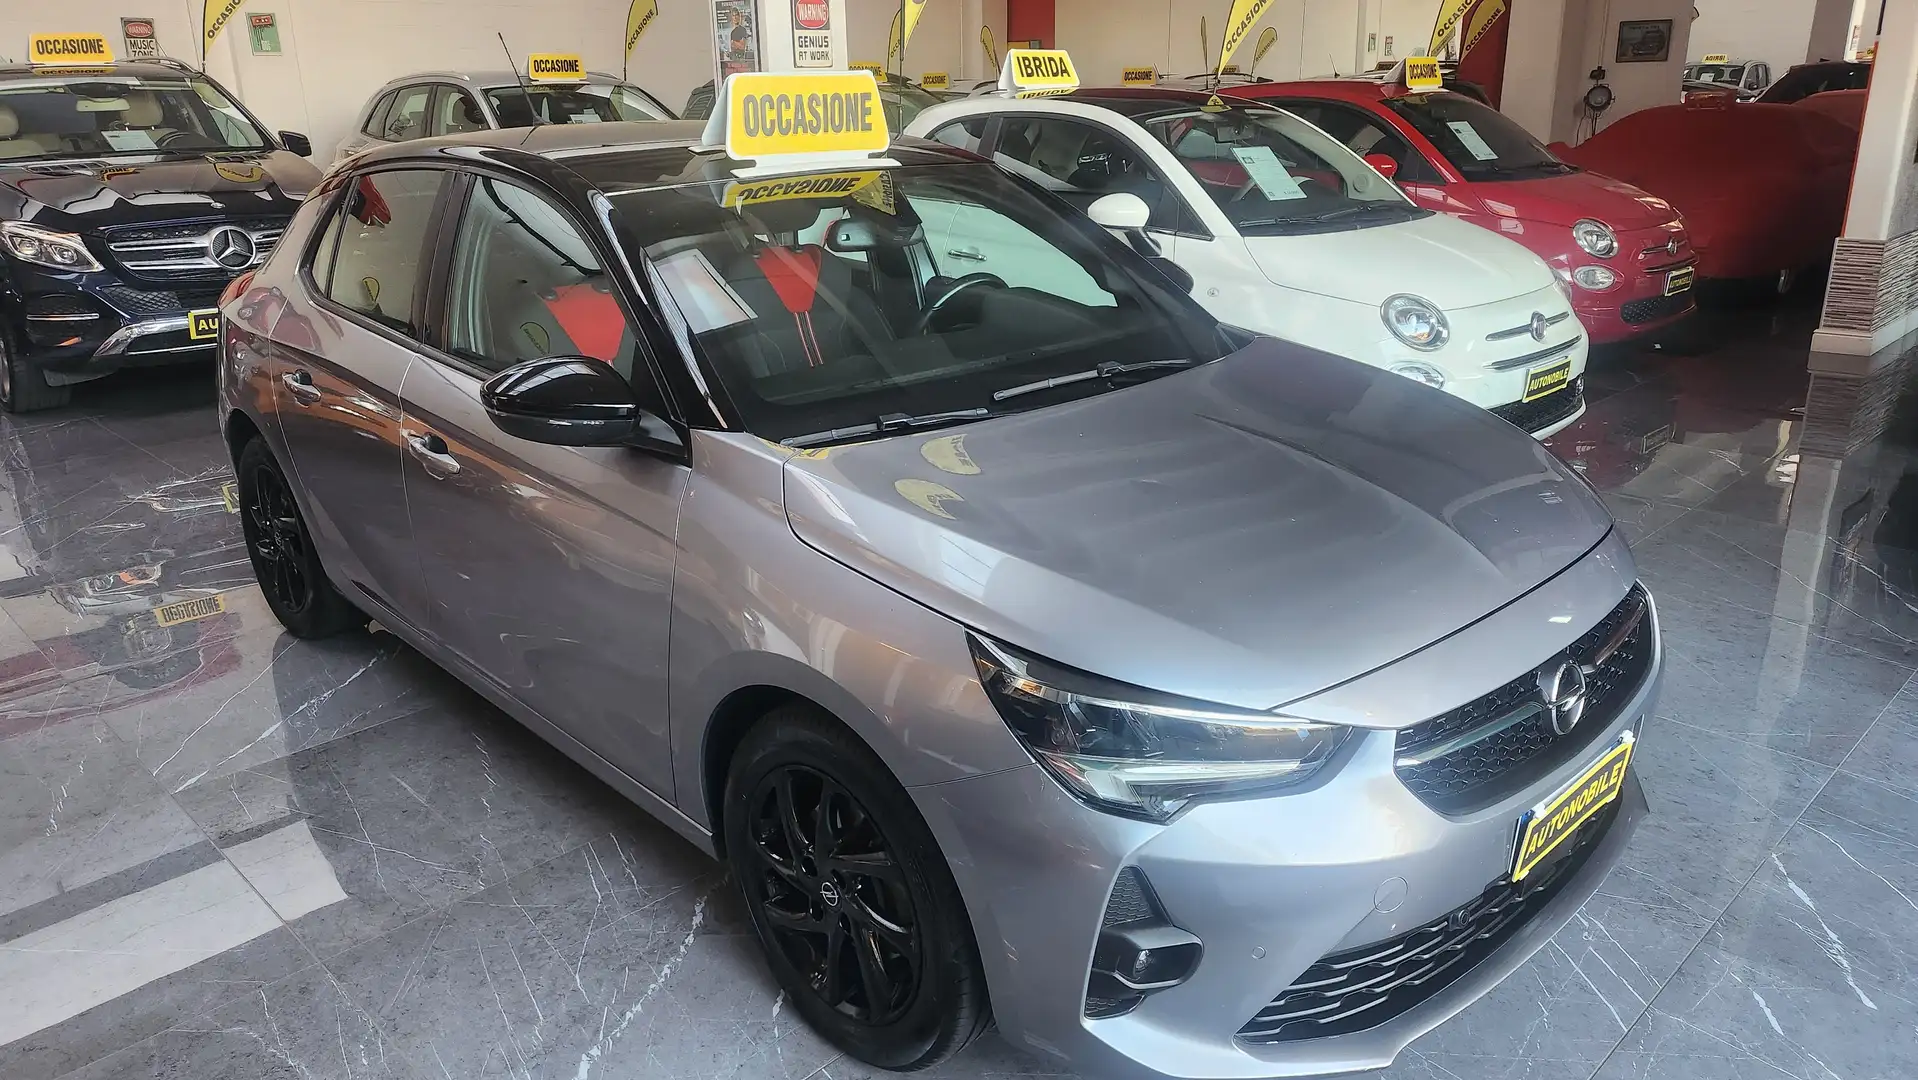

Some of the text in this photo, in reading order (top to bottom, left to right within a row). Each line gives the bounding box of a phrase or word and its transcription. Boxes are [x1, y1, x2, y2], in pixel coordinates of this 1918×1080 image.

[798, 3, 827, 21] WARNING
[627, 8, 655, 50] OCCASIONE
[1465, 7, 1502, 51] OCCASIONE
[36, 38, 105, 55] OCCASIONE
[129, 40, 155, 50] MUSIC
[798, 36, 829, 48] GENIUS
[798, 51, 830, 60] AT WORK
[533, 59, 579, 73] OCCASIONE
[1016, 56, 1071, 78] IBRIDA
[1409, 63, 1438, 80] OCCASIONE
[923, 75, 946, 85] OCCASIONE
[1124, 70, 1153, 82] OCCASIONE
[743, 92, 873, 138] OCCASIONE
